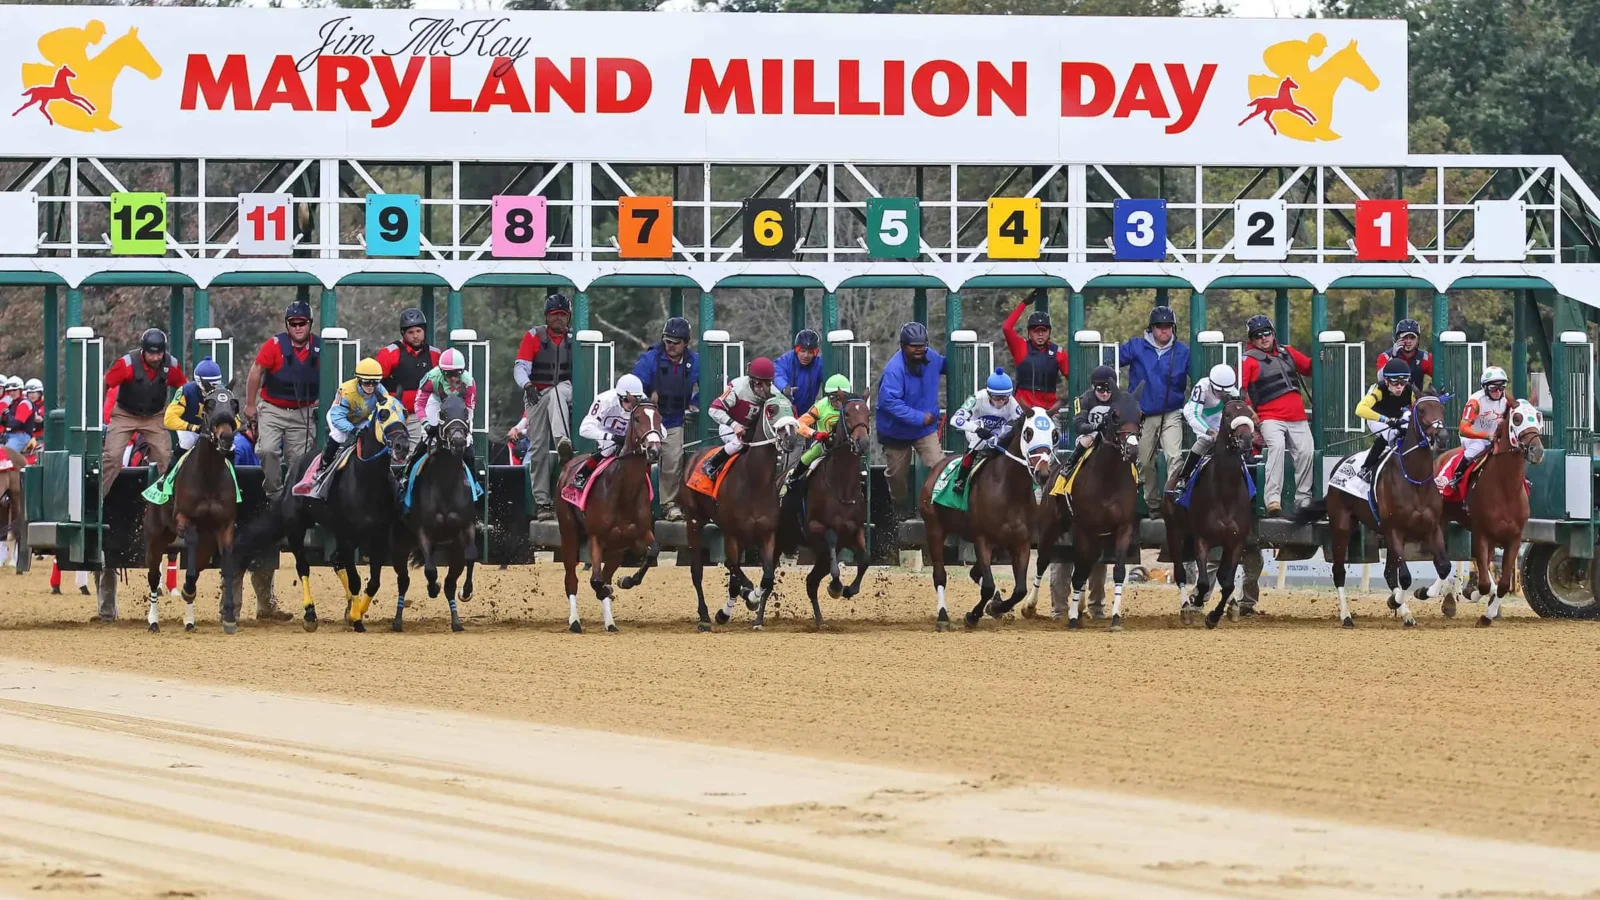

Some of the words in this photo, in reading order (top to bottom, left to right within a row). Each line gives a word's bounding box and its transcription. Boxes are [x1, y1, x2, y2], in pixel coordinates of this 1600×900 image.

[295, 16, 375, 72] Jim
[381, 17, 532, 78] McKay
[181, 53, 653, 128] MARYLAND
[685, 58, 1027, 117] MILLION
[1061, 61, 1217, 135] DAY
[113, 205, 163, 240] 12
[246, 206, 285, 240] 11
[379, 207, 408, 242] 9
[505, 208, 533, 243] 8
[631, 209, 659, 243] 7
[754, 210, 783, 246] 6
[879, 210, 908, 246] 5
[998, 211, 1028, 244] 4
[1126, 211, 1154, 246] 3
[1246, 212, 1274, 246] 2
[1373, 212, 1391, 246] 1
[591, 403, 600, 416] 8
[745, 404, 760, 420] P
[964, 396, 975, 409] 5
[1037, 420, 1049, 428] SL
